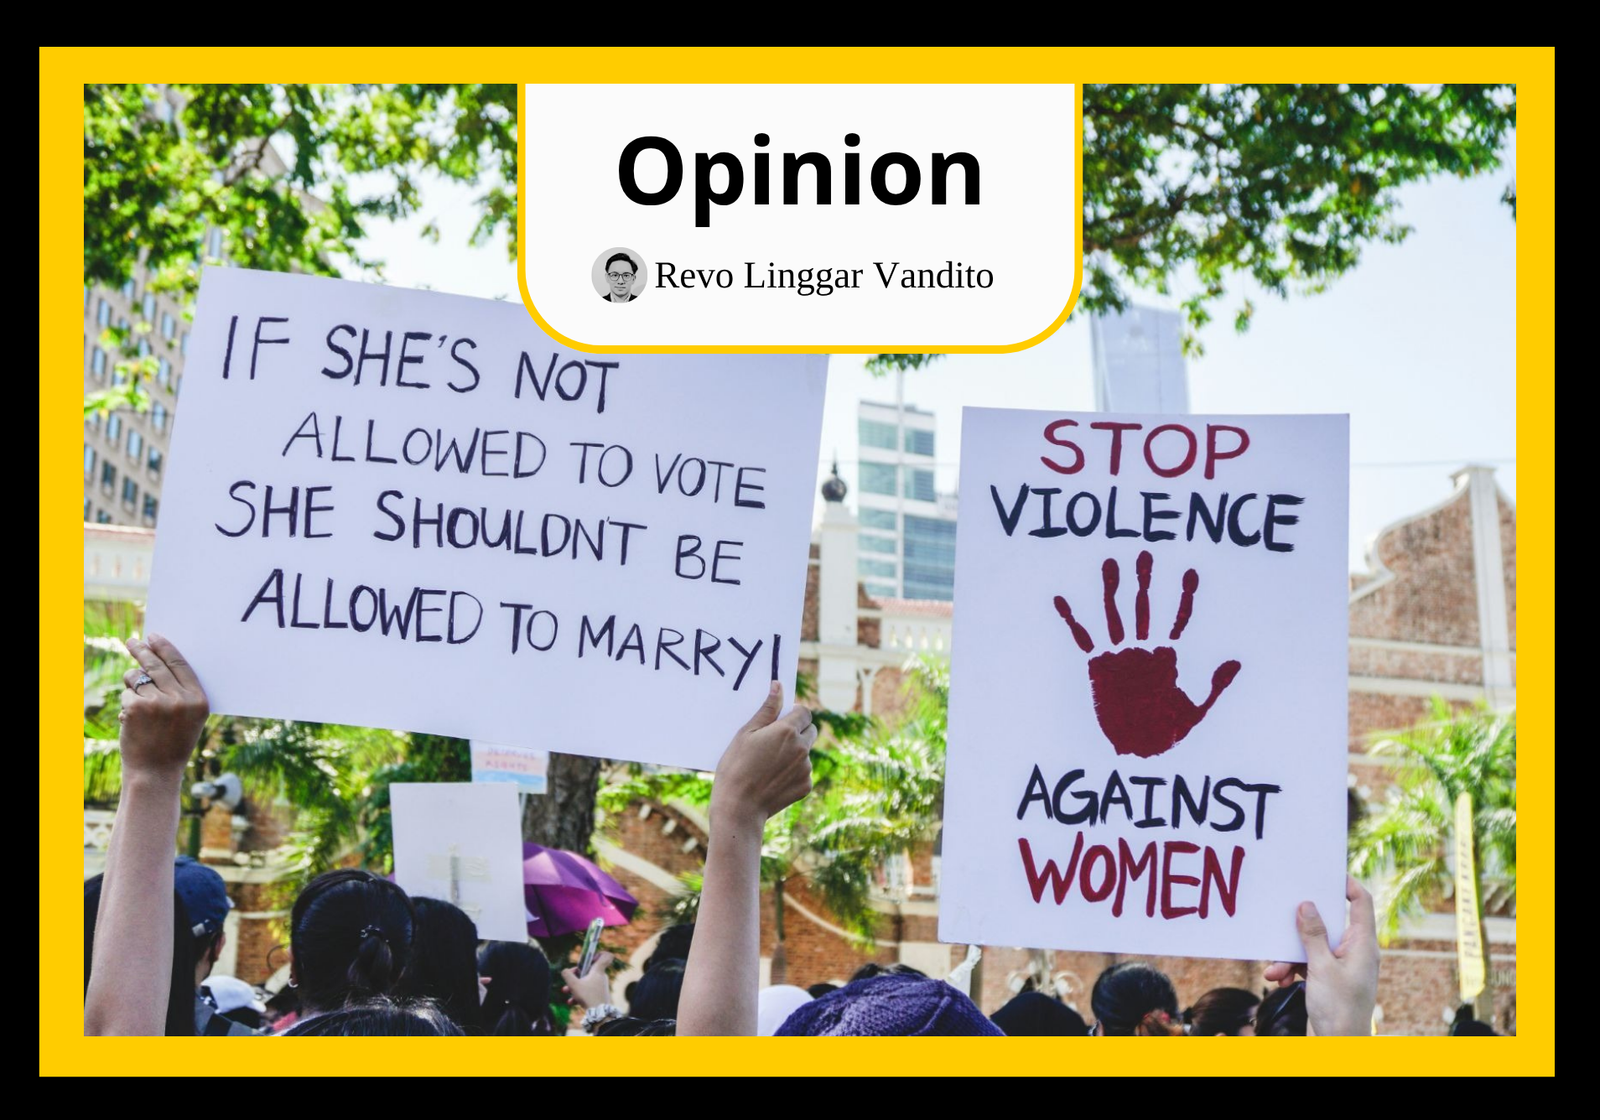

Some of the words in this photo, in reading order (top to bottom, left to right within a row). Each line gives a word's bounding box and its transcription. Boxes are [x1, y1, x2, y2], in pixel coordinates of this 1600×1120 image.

[223, 316, 290, 380] IF
[321, 324, 480, 393] SHE'S
[515, 351, 619, 414] NOT
[282, 412, 546, 479] ALLOWED
[570, 443, 633, 487] TO
[656, 454, 766, 509] VOTE
[1041, 419, 1250, 480] STOP
[215, 480, 334, 538] SHE
[374, 490, 647, 565] SHOULDN'T
[675, 535, 743, 585] BE
[990, 483, 1305, 552] VIOLENCE
[241, 569, 483, 644] ALLOWED
[500, 602, 558, 654] TO
[1017, 764, 1282, 839] AGAINST
[1018, 832, 1245, 920] WOMEN
